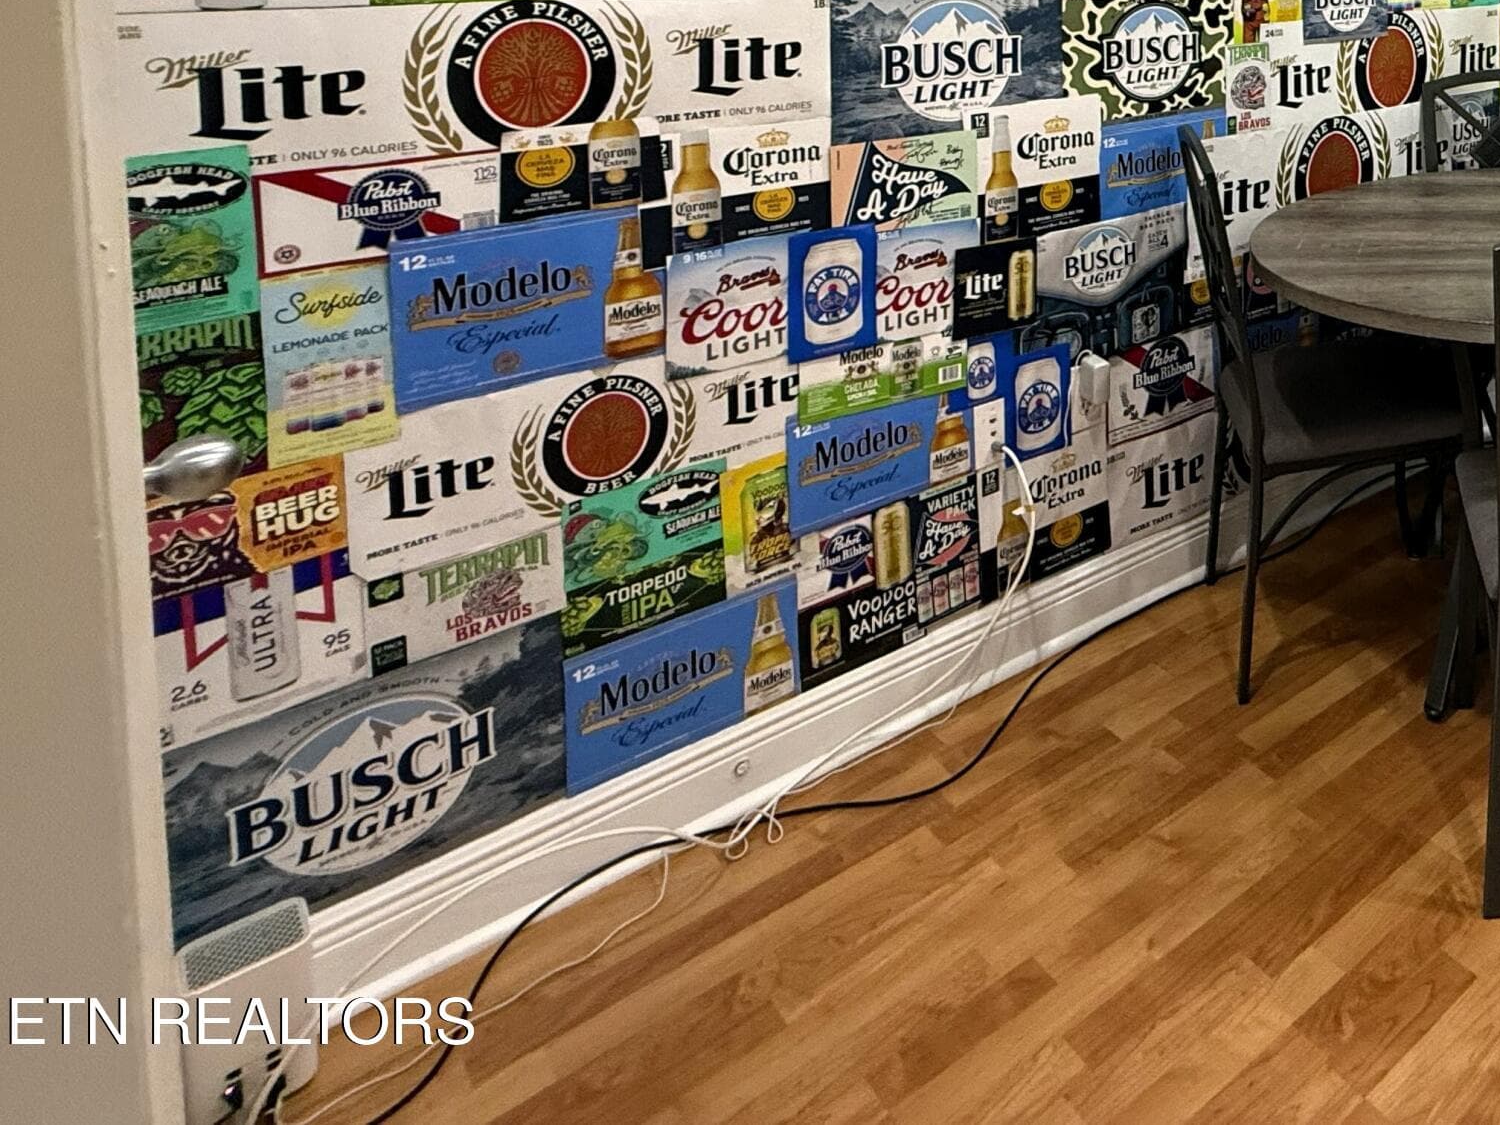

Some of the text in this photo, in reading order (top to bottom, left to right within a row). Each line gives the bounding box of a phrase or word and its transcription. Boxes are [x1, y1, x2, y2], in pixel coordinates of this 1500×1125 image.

[1265, 29, 1274, 37] 24
[145, 49, 252, 90] Miller
[883, 38, 1021, 87] BUSCH
[189, 65, 366, 141] Lite
[913, 80, 991, 104] LIGHT
[1276, 65, 1331, 108] Lite
[682, 109, 721, 121] TASTE
[1238, 117, 1271, 131] BRAVOS
[722, 142, 822, 177] Corona
[1017, 130, 1095, 162] Corona
[1038, 155, 1077, 170] Extra
[128, 164, 234, 187] DOGFISH HEAD
[750, 168, 799, 187] Extra
[871, 153, 937, 184] Have
[363, 177, 413, 198] Pabst
[340, 195, 439, 220] Blue Ribbon
[274, 287, 383, 325] Surfside
[272, 323, 389, 354] LEMONADE PACK
[815, 420, 908, 471] Modelo
[255, 485, 338, 521] BEER
[383, 455, 495, 520] Lite
[927, 485, 976, 512] VARIETY
[257, 503, 341, 541] HUG
[418, 533, 551, 605] TERRAPIN
[606, 566, 688, 607] TORPEDO
[848, 580, 915, 620] VOODOO
[254, 595, 276, 673] ULTRA
[446, 613, 473, 632] LOS
[850, 598, 917, 643] RANGER
[601, 649, 716, 716] Modelo
[232, 711, 496, 862] BUSCH
[296, 782, 448, 866] LIGHT
